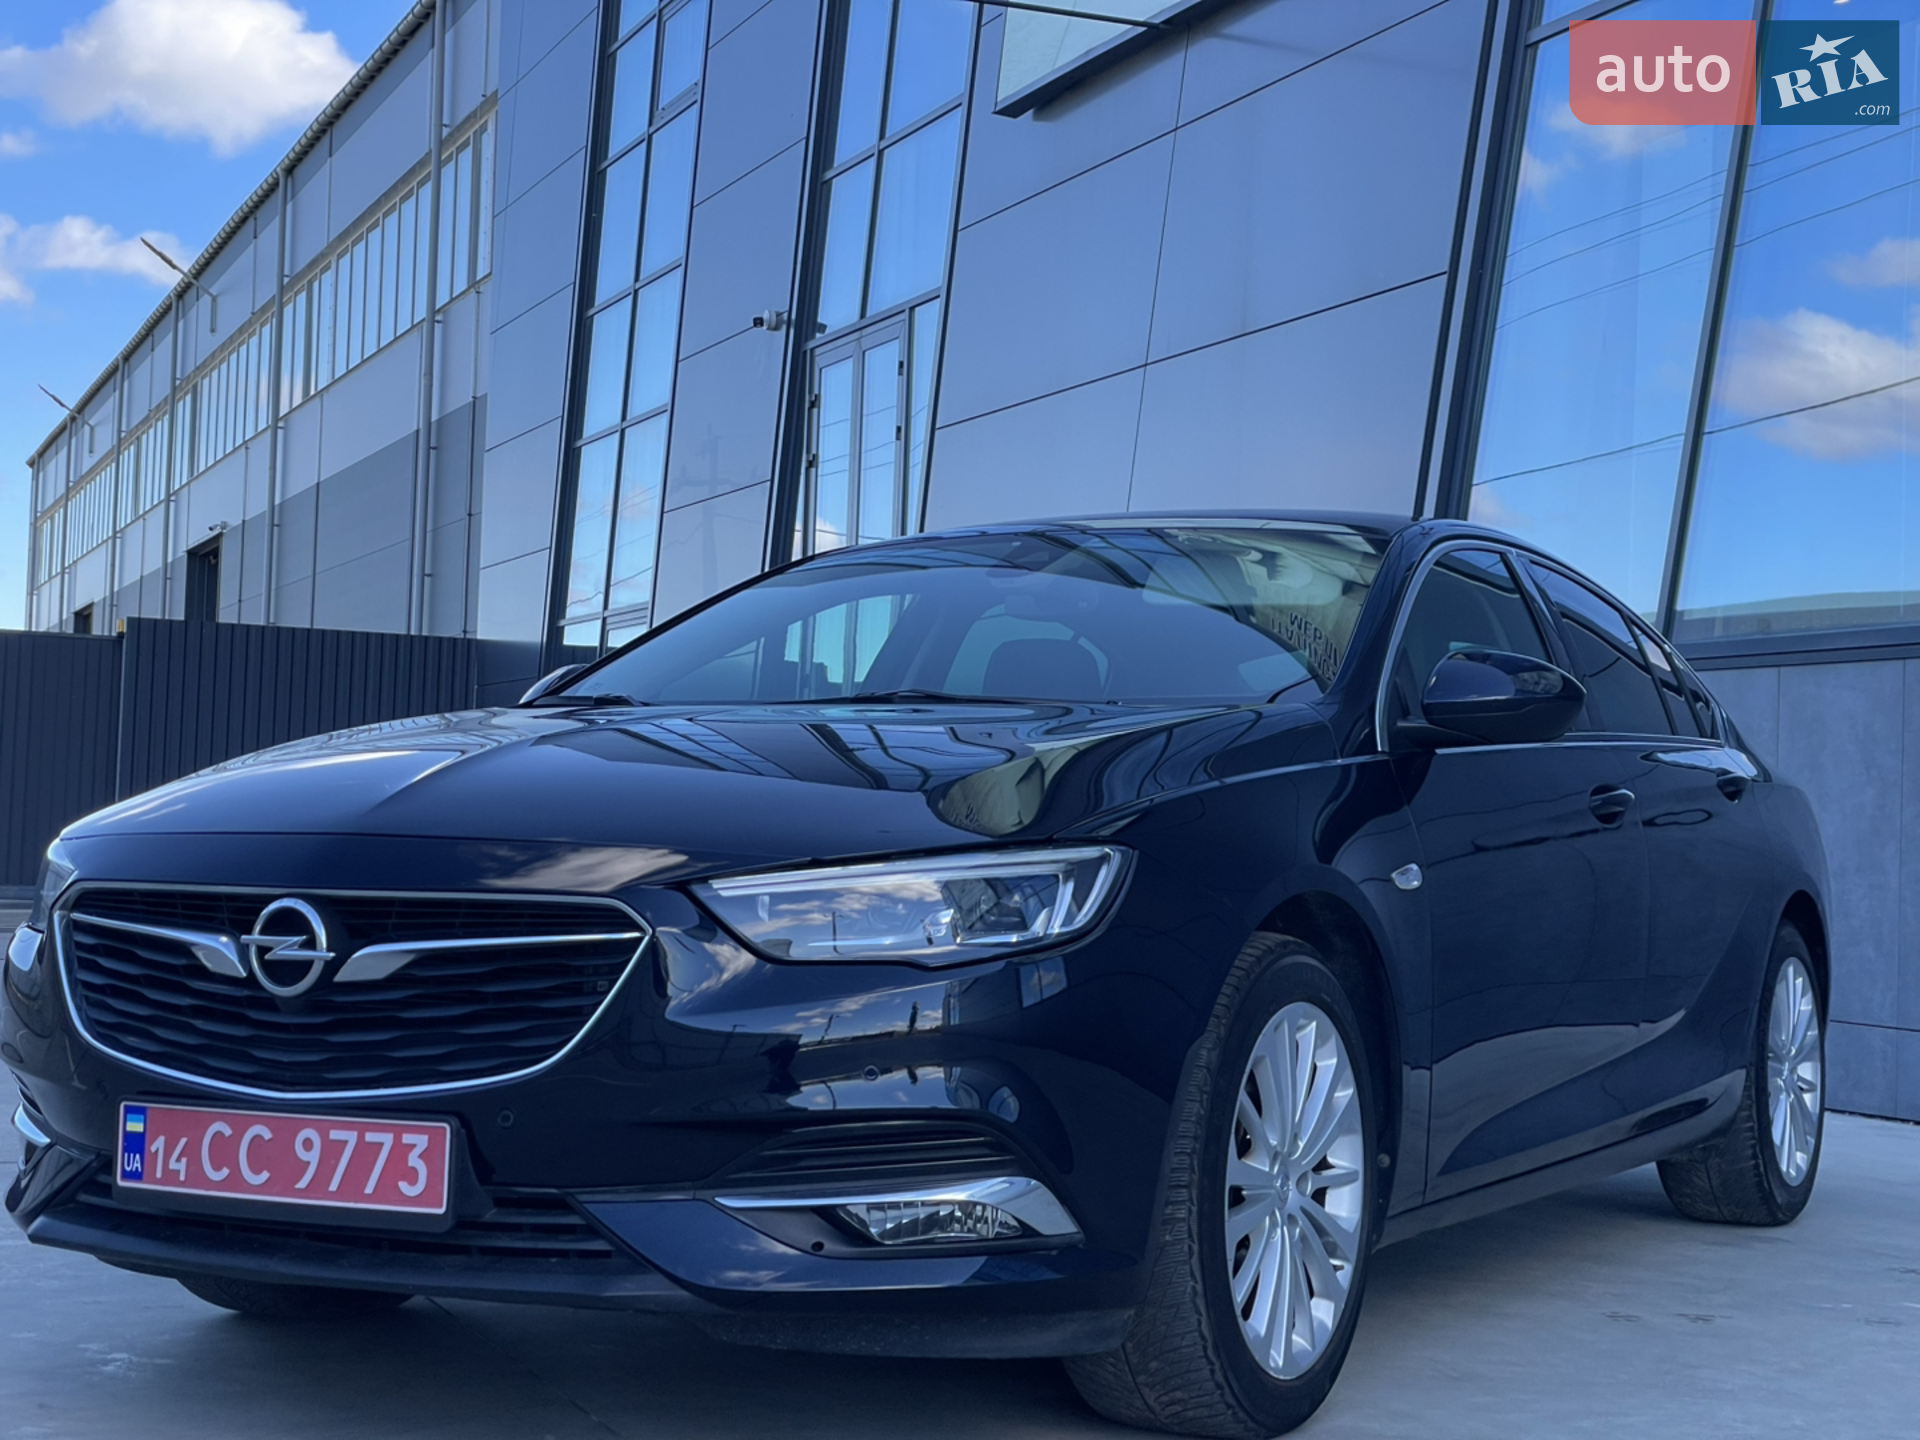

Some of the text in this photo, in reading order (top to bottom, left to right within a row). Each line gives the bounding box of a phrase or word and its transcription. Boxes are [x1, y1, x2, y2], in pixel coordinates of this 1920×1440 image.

[124, 1152, 142, 1173] UA
[149, 1121, 429, 1197] 14 CC 9773
